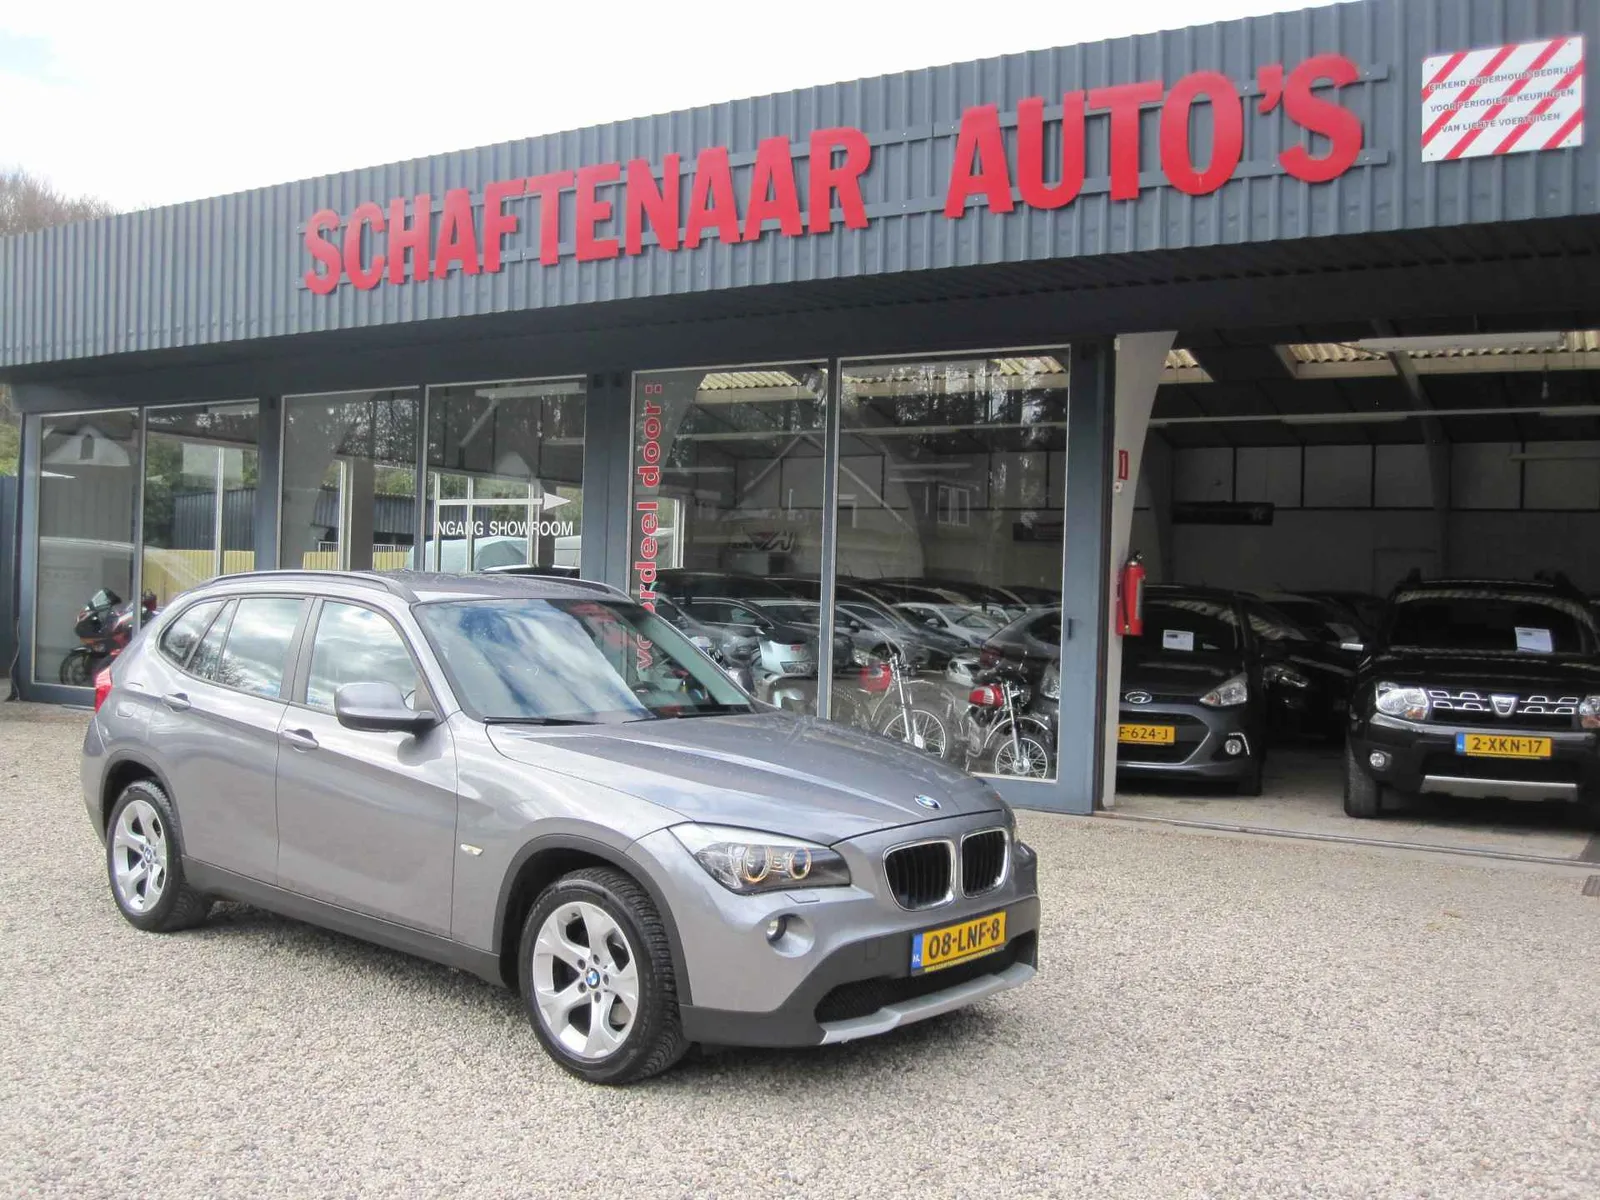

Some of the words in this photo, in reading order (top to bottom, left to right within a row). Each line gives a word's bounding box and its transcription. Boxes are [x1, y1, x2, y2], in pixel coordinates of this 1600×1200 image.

[1429, 80, 1466, 91] ERKEND
[1430, 102, 1455, 112] VOOR
[1517, 88, 1575, 103] KEURINGEN
[1442, 125, 1460, 133] VAN
[1499, 112, 1561, 126] VOERTUIGEN
[304, 127, 871, 295] SCHAFTENAAR
[944, 53, 1364, 219] AUTO'S
[433, 520, 484, 536] NGANG
[489, 520, 573, 536] SHOWROOM
[1118, 726, 1168, 739] F-624-J
[1472, 737, 1543, 754] 2-XKN-17
[928, 918, 1000, 960] 08-LNF-8
